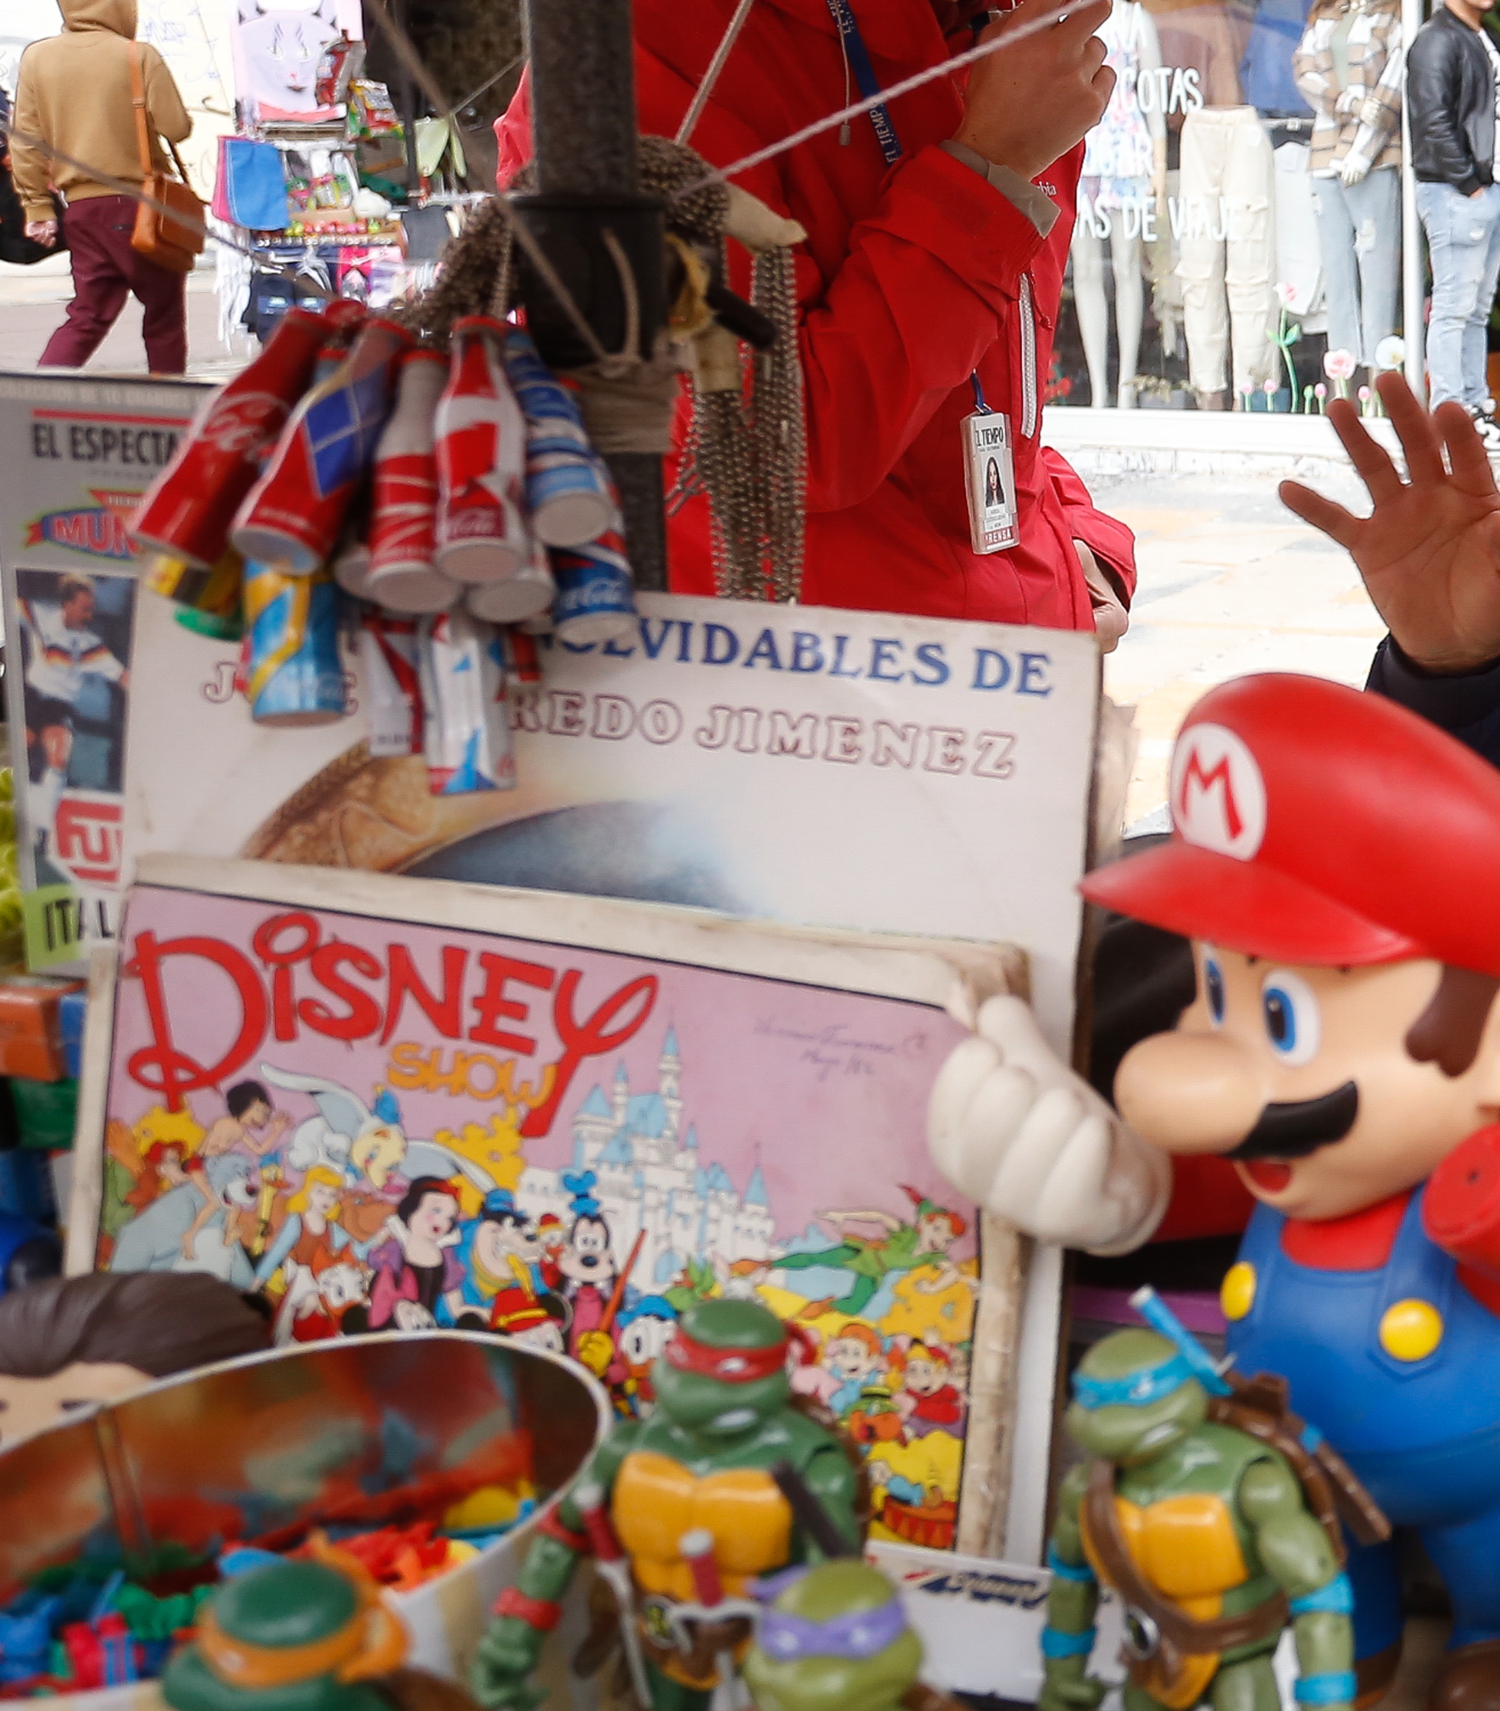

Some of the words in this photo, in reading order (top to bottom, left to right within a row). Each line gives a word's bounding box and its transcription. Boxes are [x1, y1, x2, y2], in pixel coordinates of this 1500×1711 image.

[1121, 195, 1158, 242] DE
[1167, 195, 1244, 242] VIAJE
[33, 423, 61, 459] EL
[973, 648, 1055, 698] DE
[694, 703, 1018, 780] JIMENEZ
[1181, 745, 1244, 843] M
[388, 1041, 562, 1110] SHOW
